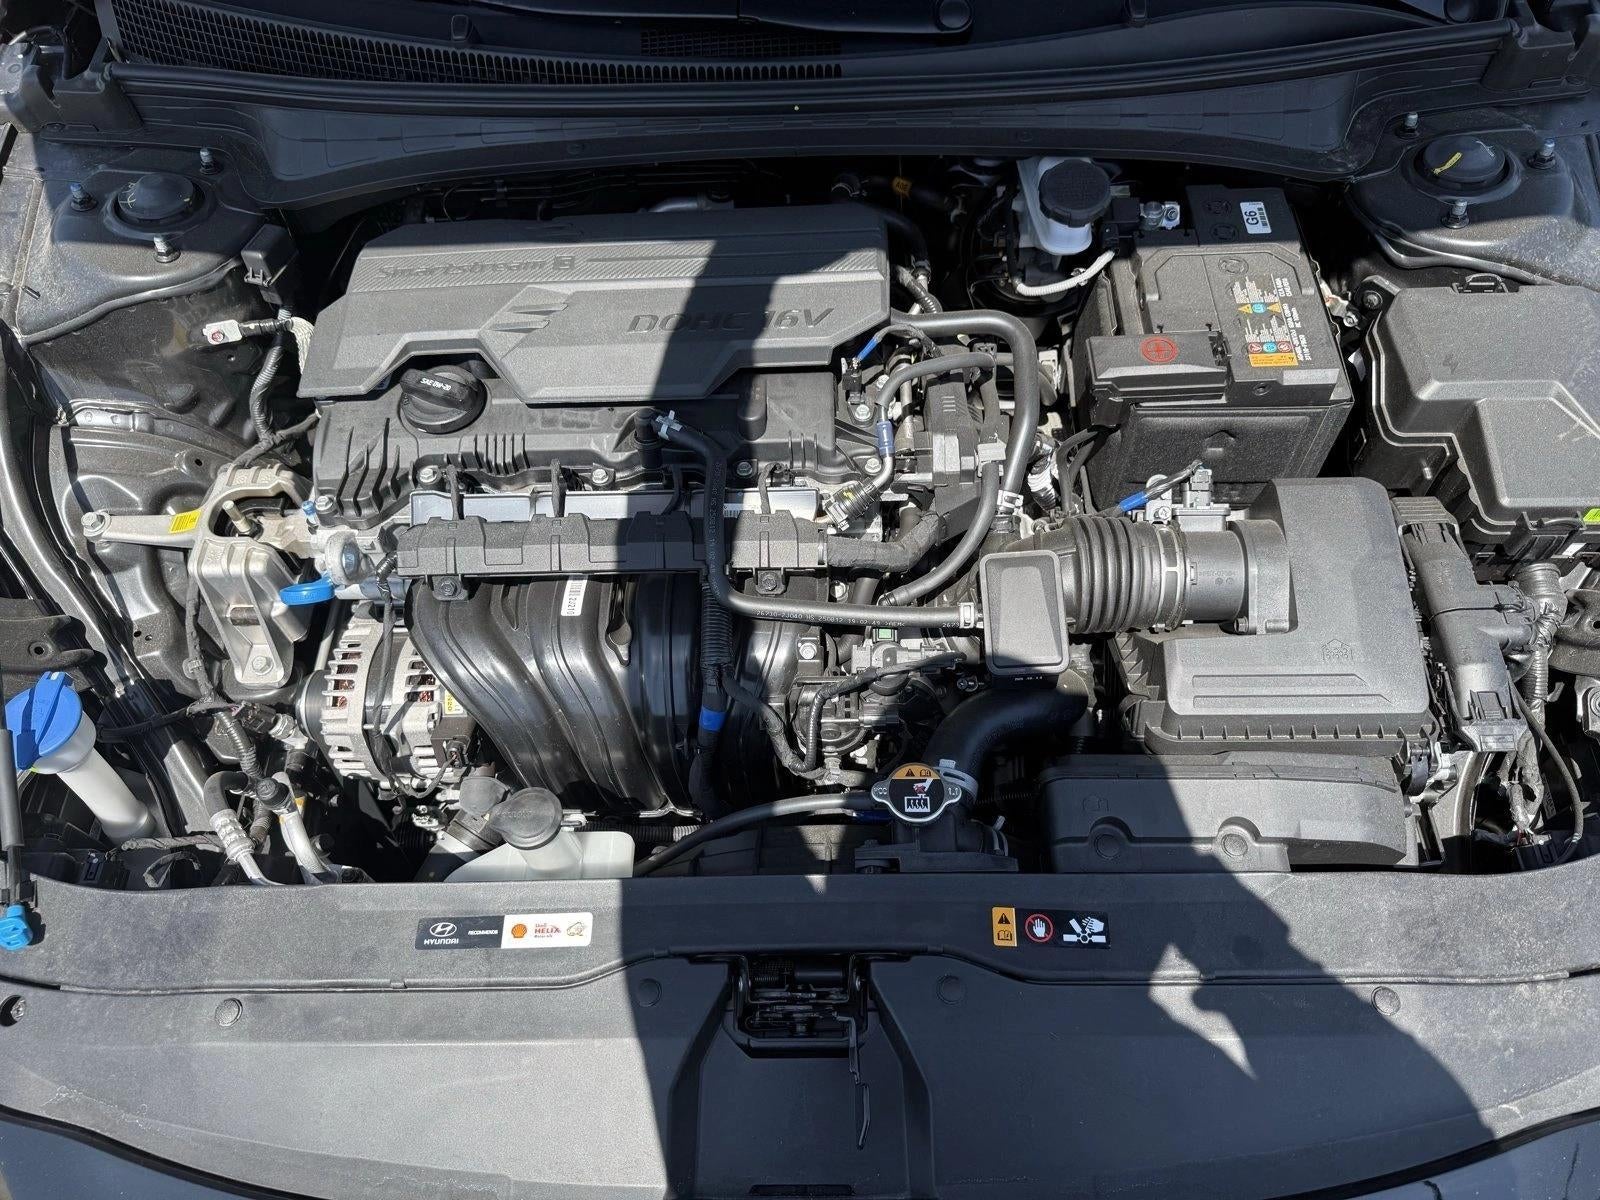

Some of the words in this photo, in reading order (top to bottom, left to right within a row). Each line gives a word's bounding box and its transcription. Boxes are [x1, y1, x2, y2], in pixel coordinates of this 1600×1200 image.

[1245, 210, 1259, 226] G6
[626, 311, 752, 334] DOHC
[764, 307, 835, 329] 16V
[420, 377, 433, 386] SAE
